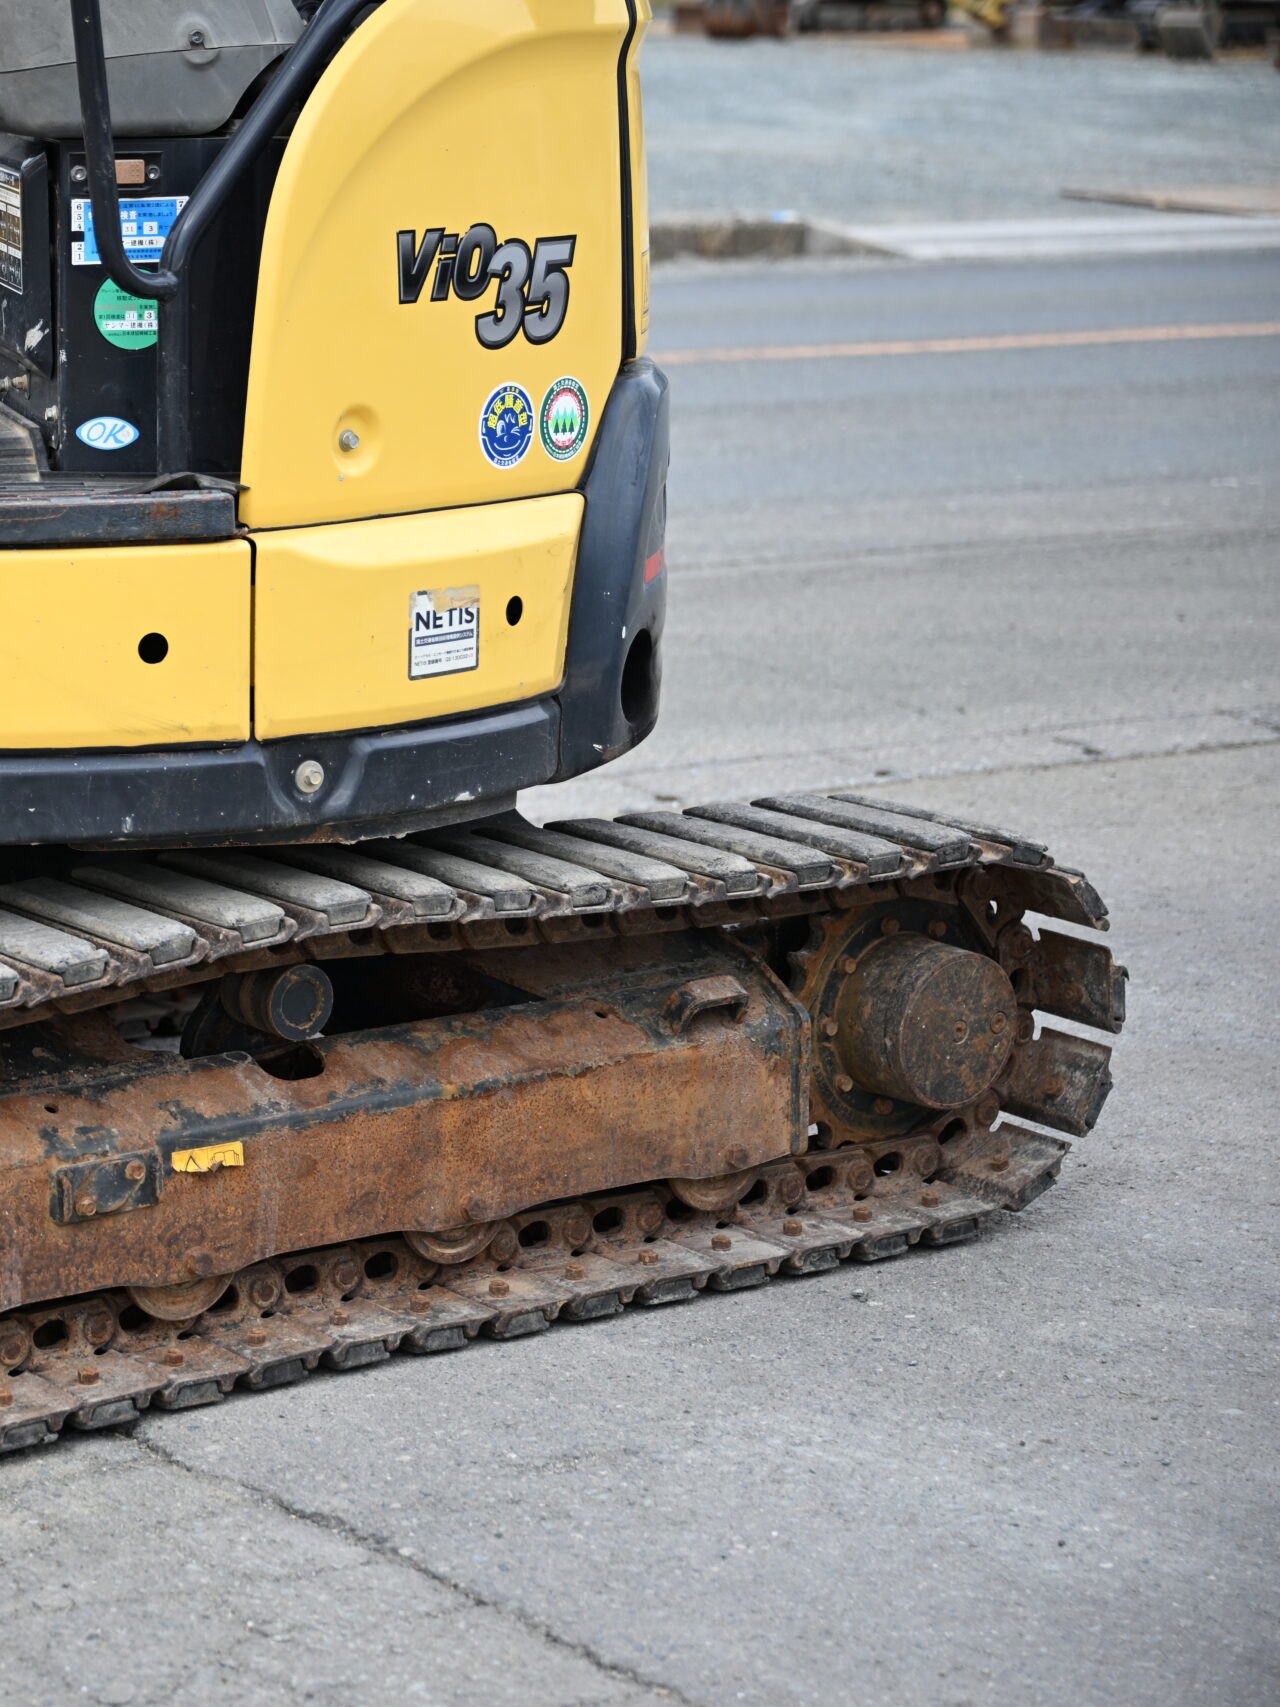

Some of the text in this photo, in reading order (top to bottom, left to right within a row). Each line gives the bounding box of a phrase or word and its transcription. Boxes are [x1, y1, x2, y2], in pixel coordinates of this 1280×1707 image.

[178, 200, 184, 208] 7
[76, 213, 82, 221] 5
[487, 394, 528, 430] 超低騒音型
[87, 421, 125, 444] OK
[415, 606, 475, 632] NETIS
